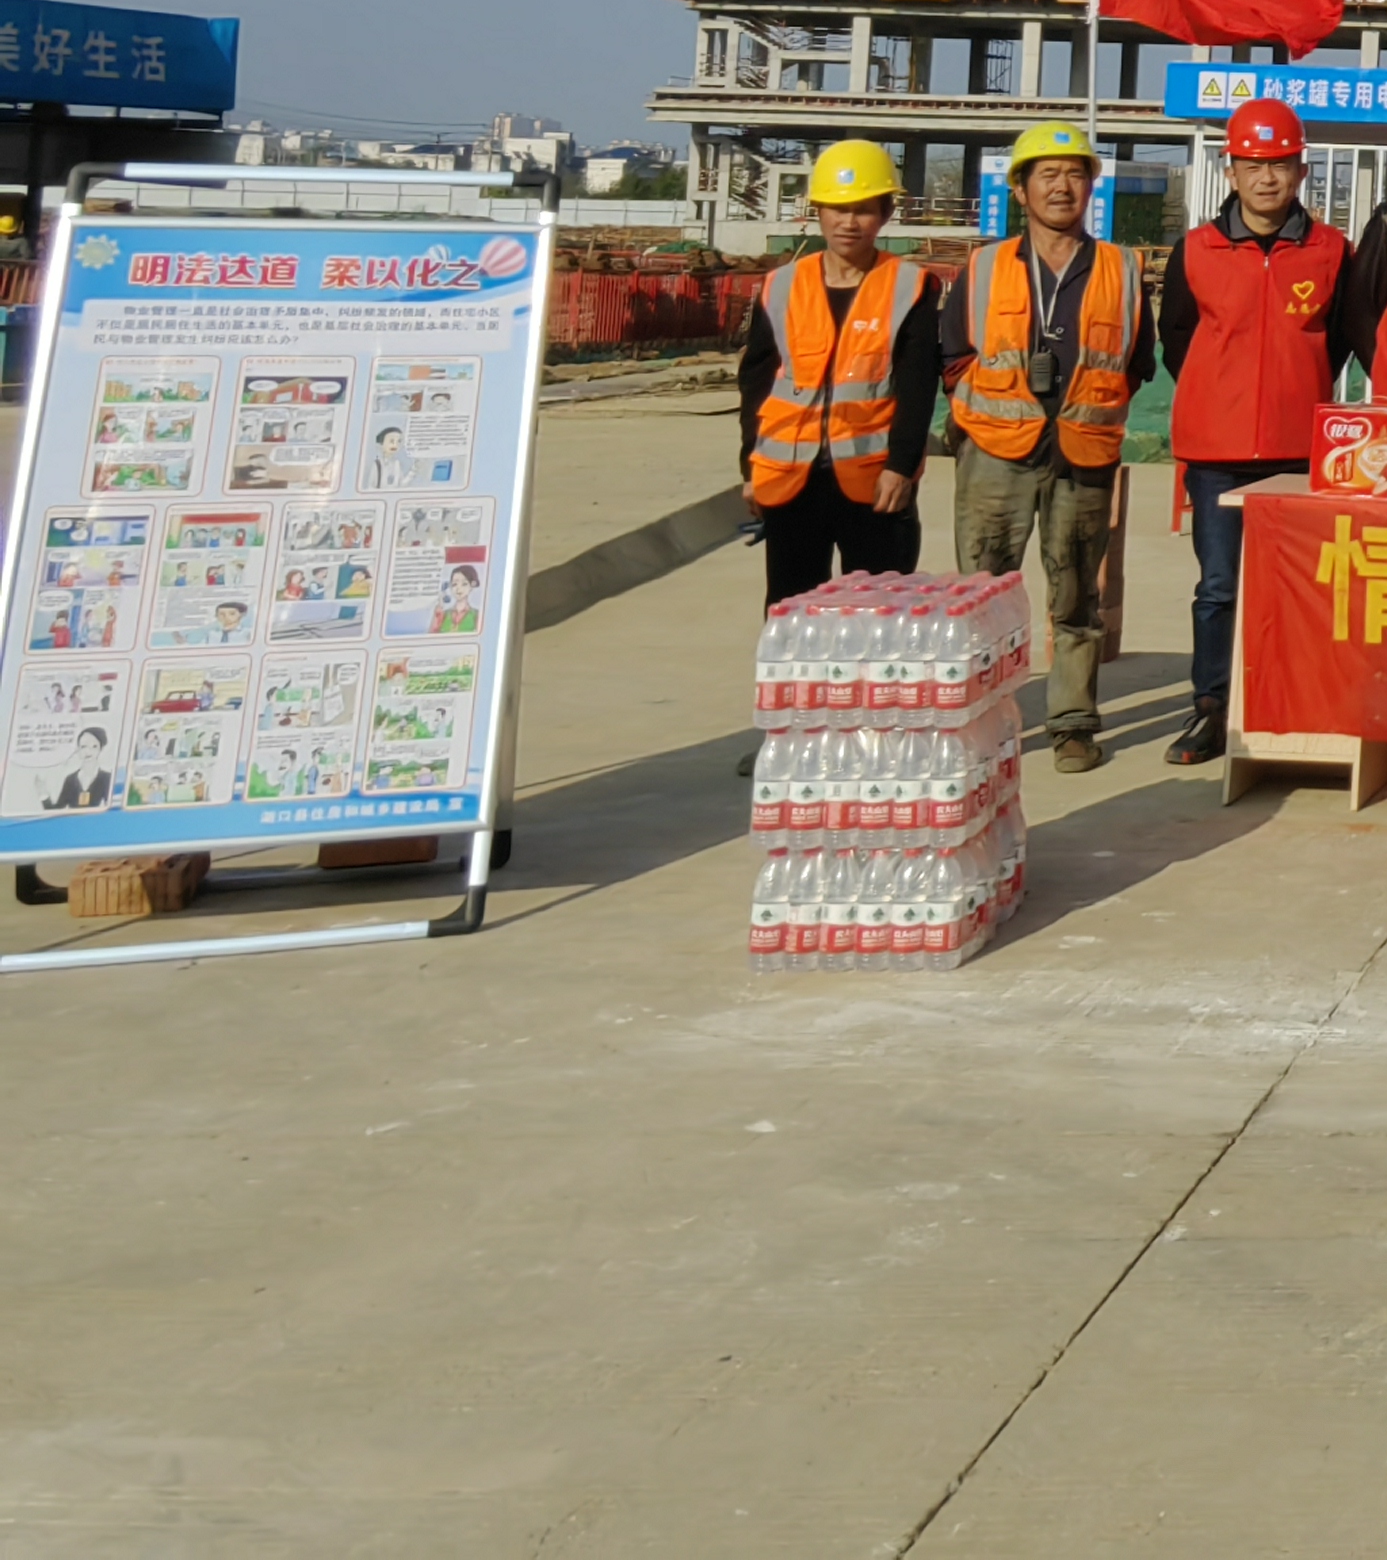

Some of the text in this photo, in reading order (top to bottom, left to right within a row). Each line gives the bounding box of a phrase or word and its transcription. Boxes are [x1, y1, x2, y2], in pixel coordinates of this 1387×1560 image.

[0, 22, 166, 82] 美好生活
[128, 252, 483, 291] 明法达道 柔以化之
